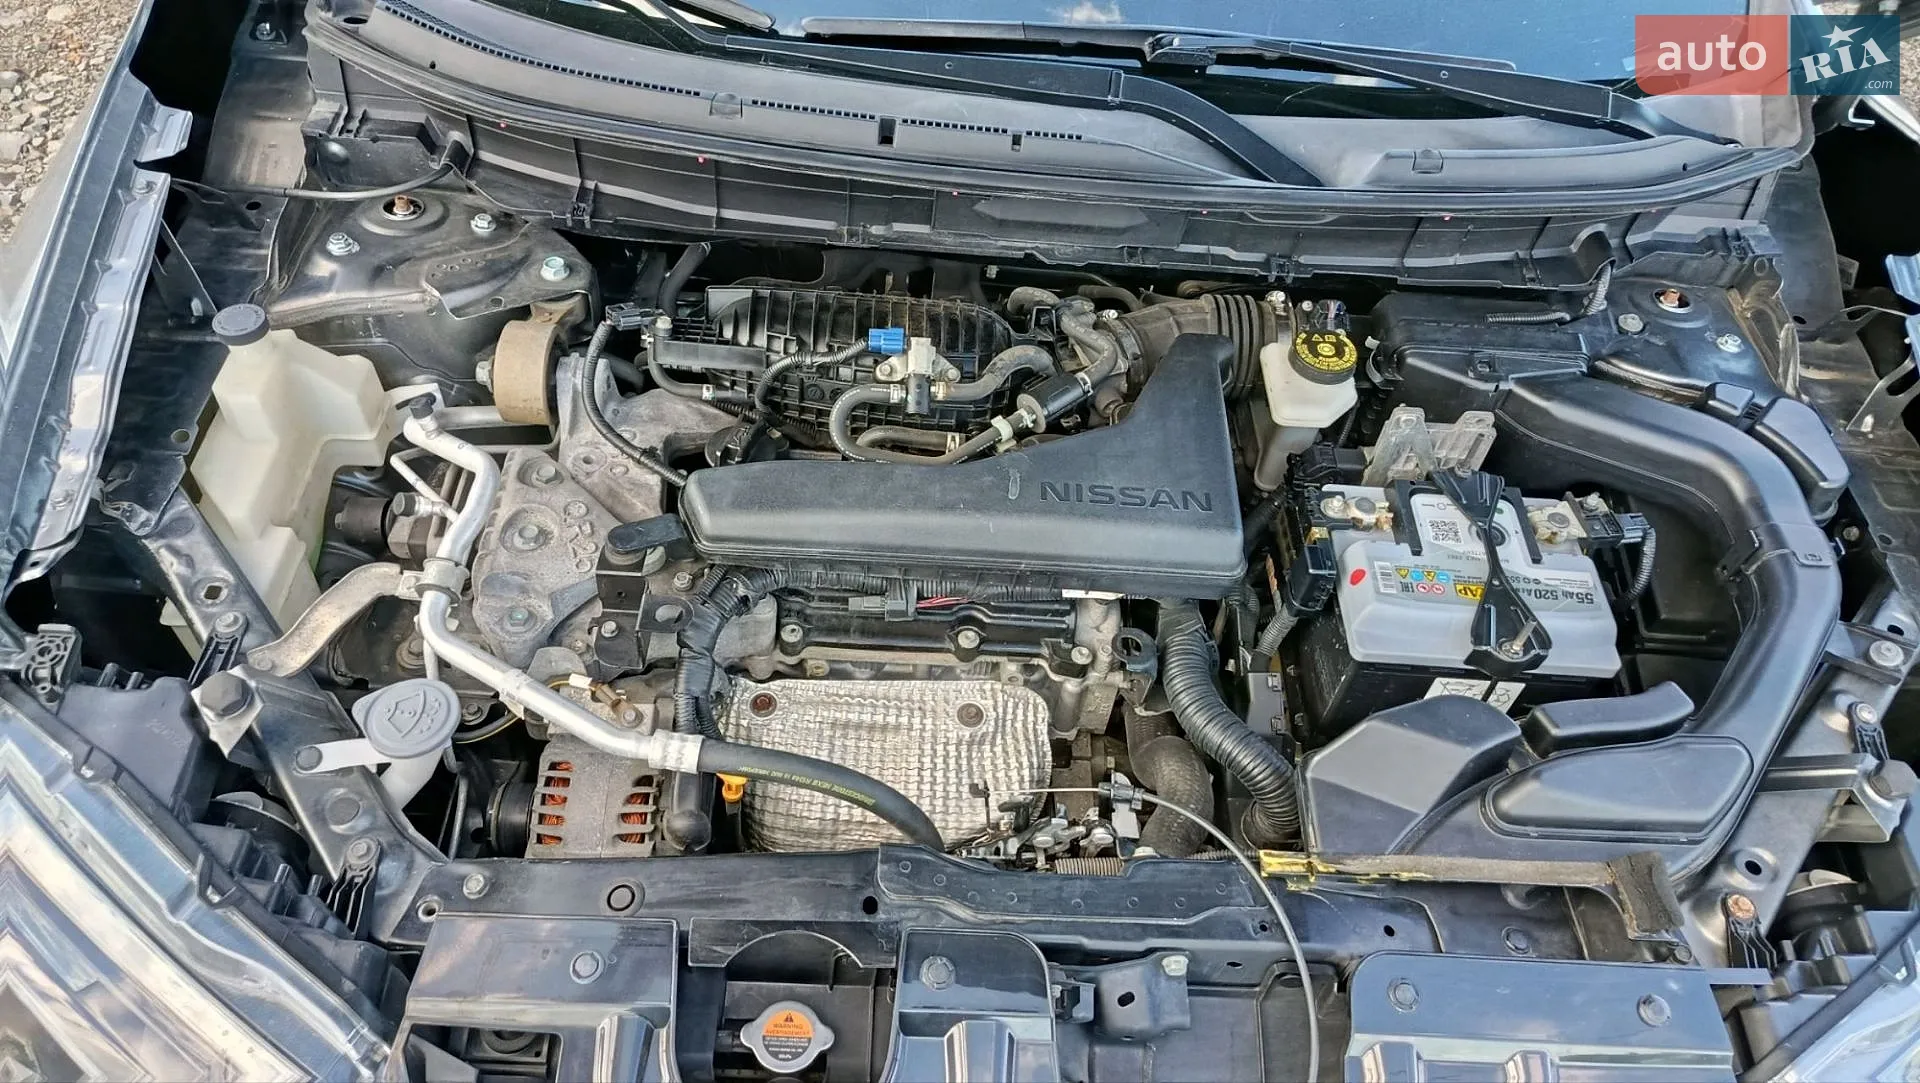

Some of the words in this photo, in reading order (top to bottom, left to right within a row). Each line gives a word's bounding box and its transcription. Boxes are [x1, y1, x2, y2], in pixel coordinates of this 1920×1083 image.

[1040, 481, 1213, 512] NISSAN
[1534, 588, 1559, 600] 520
[1576, 592, 1594, 604] 55
